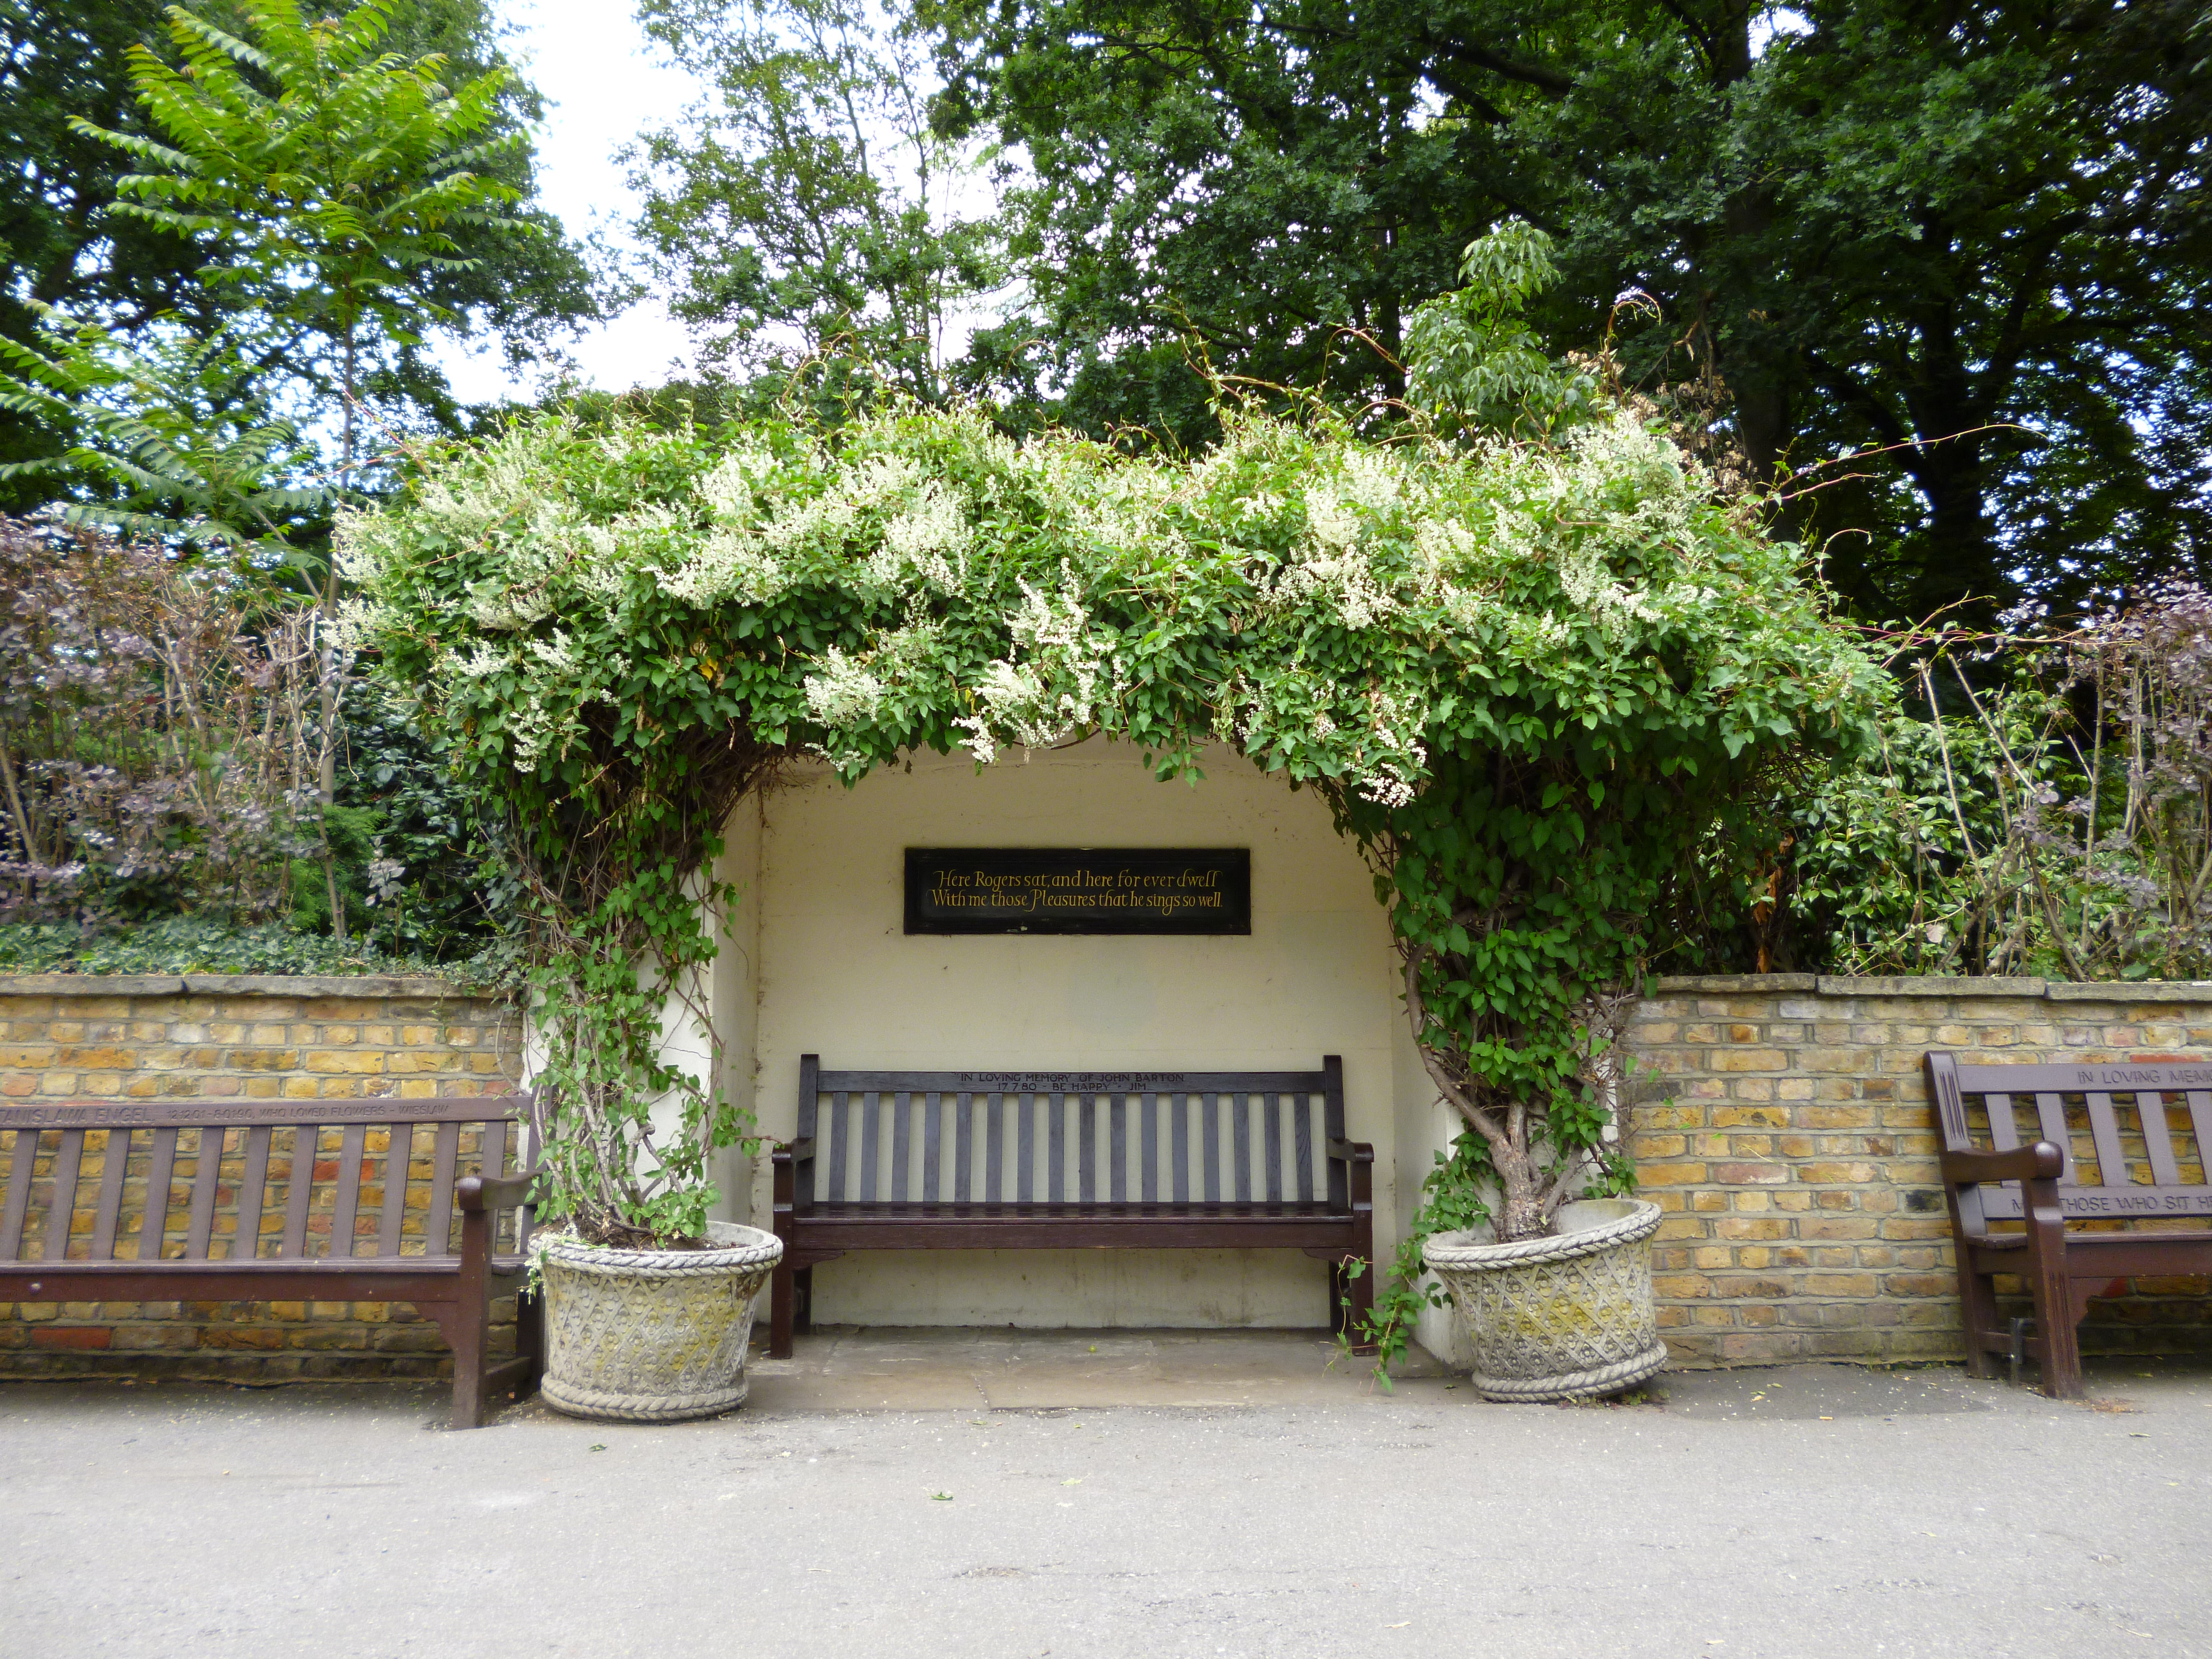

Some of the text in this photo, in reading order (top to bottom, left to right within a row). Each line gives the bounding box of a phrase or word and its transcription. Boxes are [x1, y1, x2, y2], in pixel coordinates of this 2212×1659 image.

[933, 869, 971, 889] Here
[974, 871, 1021, 892] Rogers
[1084, 870, 1114, 887] here
[1118, 868, 1141, 887] for
[1143, 876, 1175, 887] ever
[1177, 868, 1223, 887] dwell
[926, 889, 966, 907] With
[968, 895, 989, 906] me
[991, 890, 1029, 906] those
[1023, 889, 1096, 912] Pleasures
[1099, 889, 1128, 907] that
[1130, 890, 1145, 907] he
[1146, 893, 1180, 916] sings
[1182, 895, 1196, 906] so
[1026, 1073, 1070, 1082] MEMORY
[1100, 1073, 1130, 1082] JOHN
[1135, 1073, 1184, 1082] BARTON
[2078, 1071, 2093, 1084] IN
[2102, 1070, 2160, 1083] LOVING
[1053, 1083, 1066, 1091] BE
[1129, 1082, 1146, 1091] JIM
[260, 1108, 286, 1118] WHO
[290, 1107, 326, 1118] LOVED
[331, 1106, 385, 1117] FLOWERS
[2059, 1196, 2212, 1211] THOSE WHO SIT H
